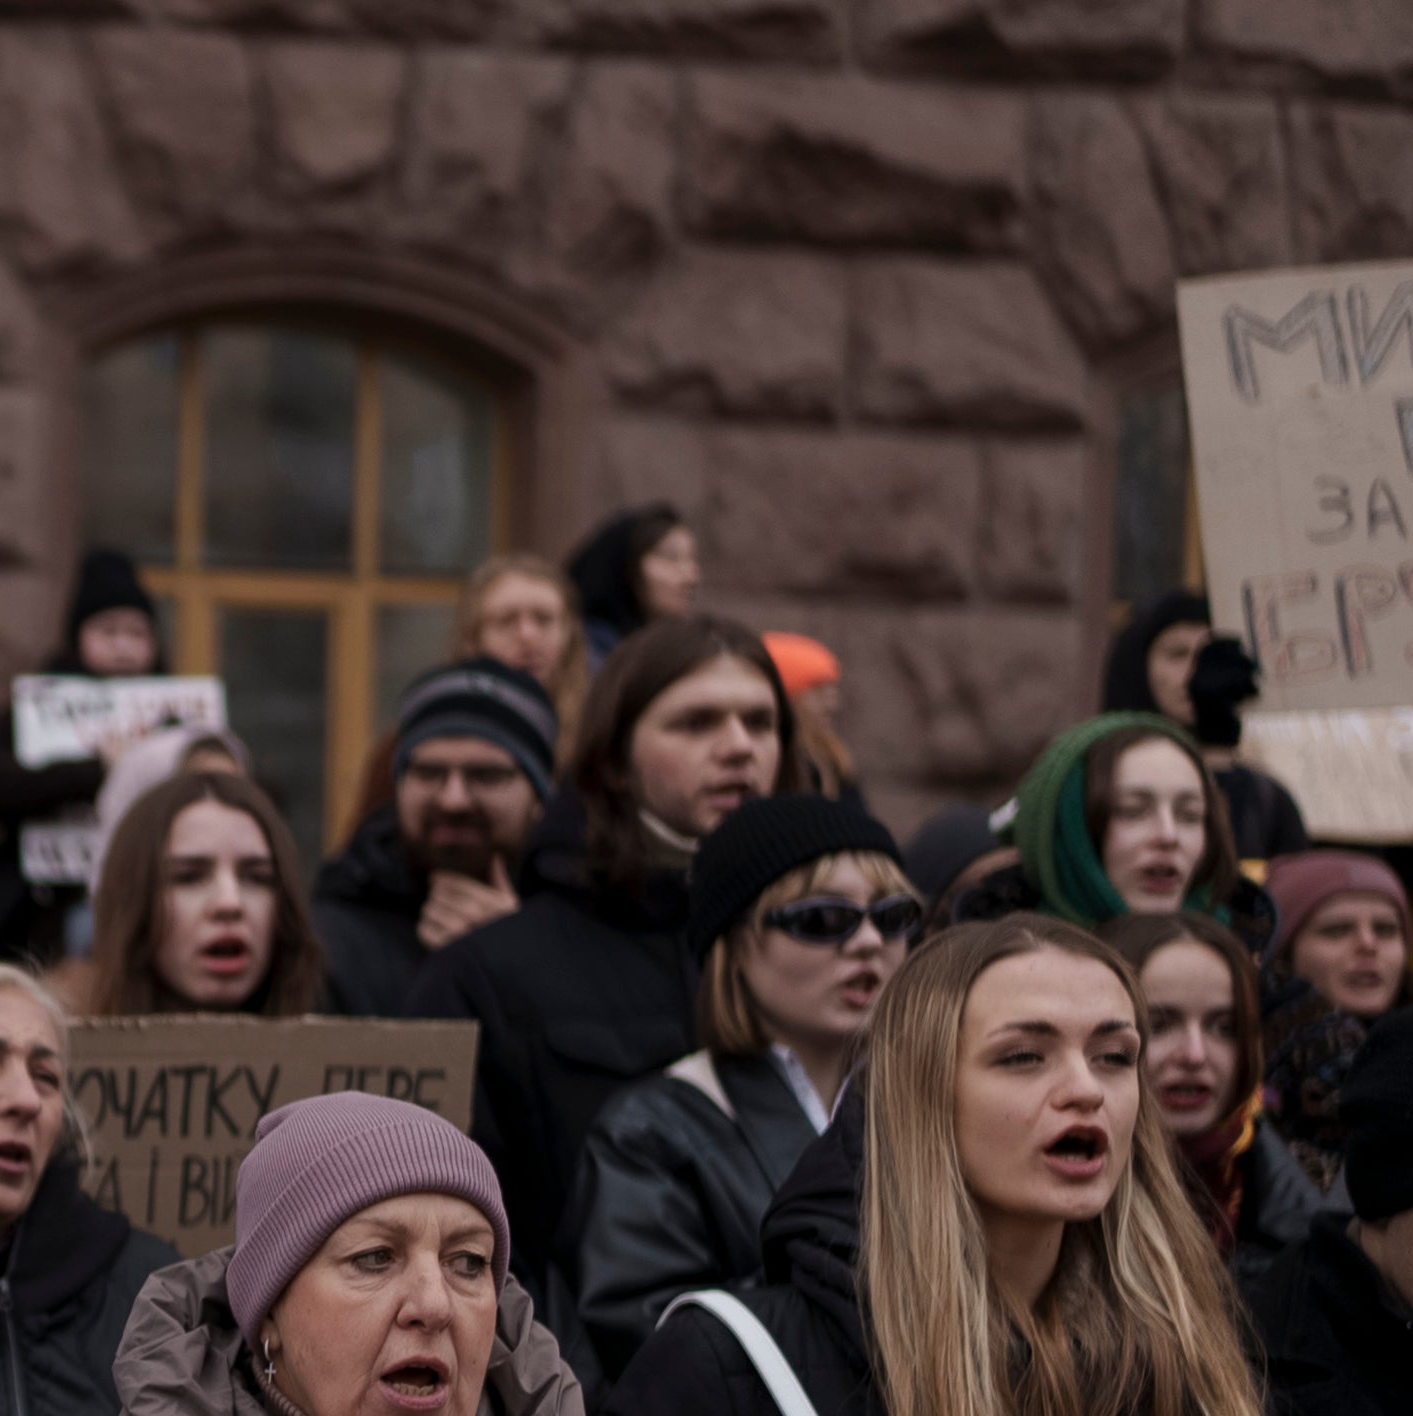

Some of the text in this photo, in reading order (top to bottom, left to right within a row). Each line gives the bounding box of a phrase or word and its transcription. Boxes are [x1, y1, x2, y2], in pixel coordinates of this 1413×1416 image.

[1305, 473, 1408, 545] ЗА
[1240, 566, 1413, 682] БР
[67, 1064, 280, 1140] ОЧАТКУ
